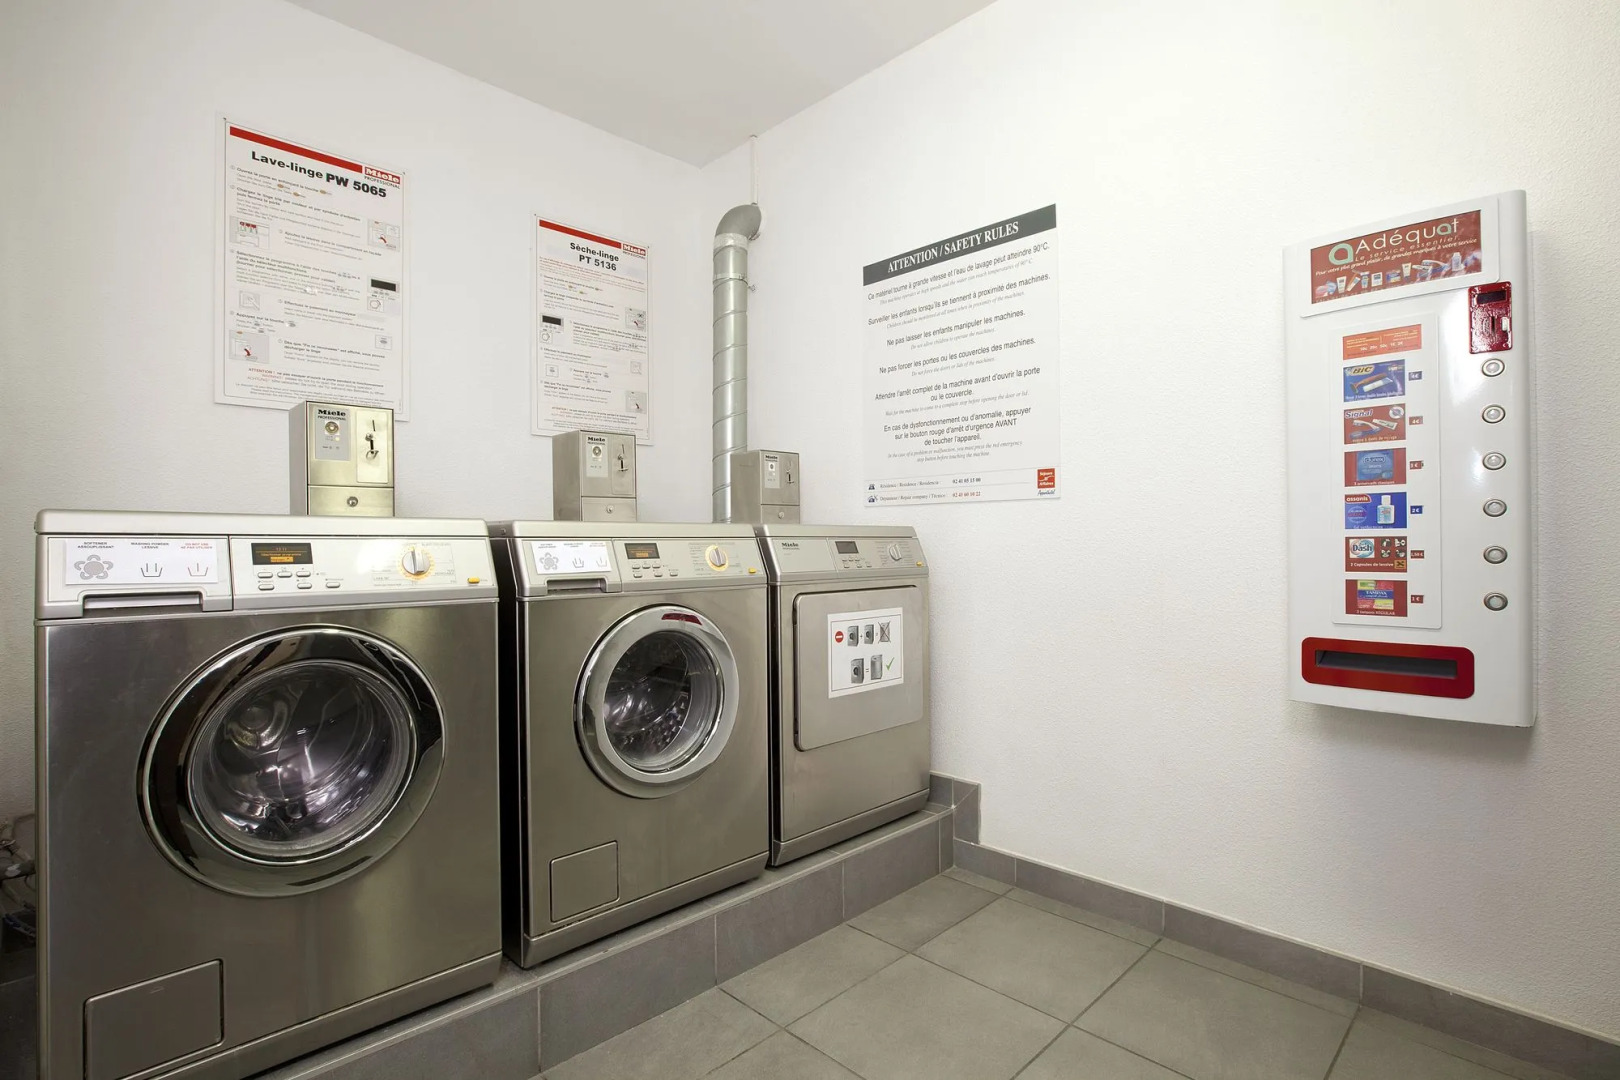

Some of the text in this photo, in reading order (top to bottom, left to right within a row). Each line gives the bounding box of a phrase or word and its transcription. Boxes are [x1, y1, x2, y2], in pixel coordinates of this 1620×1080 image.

[252, 151, 386, 198] Lave-linge PW 5065
[366, 167, 400, 184] Miele
[1355, 218, 1459, 254] Adéquat
[570, 242, 619, 261] Sèche-linge
[623, 244, 646, 256] Miele
[888, 221, 1018, 272] ATTENTION / SAFETY RULES
[1350, 260, 1364, 268] grand
[1391, 250, 1411, 260] grandes
[1458, 236, 1476, 245] service
[579, 255, 617, 271] PT 5136
[894, 337, 904, 345] pas
[905, 333, 922, 341] laisser
[932, 326, 952, 336] enfants
[953, 319, 982, 330] manipuler
[887, 365, 897, 373] pas
[922, 356, 939, 366] portes
[958, 346, 989, 358] couvercles
[912, 385, 932, 394] complet
[948, 378, 972, 387] machine
[974, 374, 990, 384] avant
[991, 370, 1014, 381] d'ouvrir
[1023, 367, 1040, 377] porte
[1005, 407, 1030, 417] appuyer
[1346, 409, 1373, 418] Signal
[964, 422, 993, 431] d'urgence
[994, 417, 1016, 427] AVANT
[1353, 543, 1372, 552] Dash
